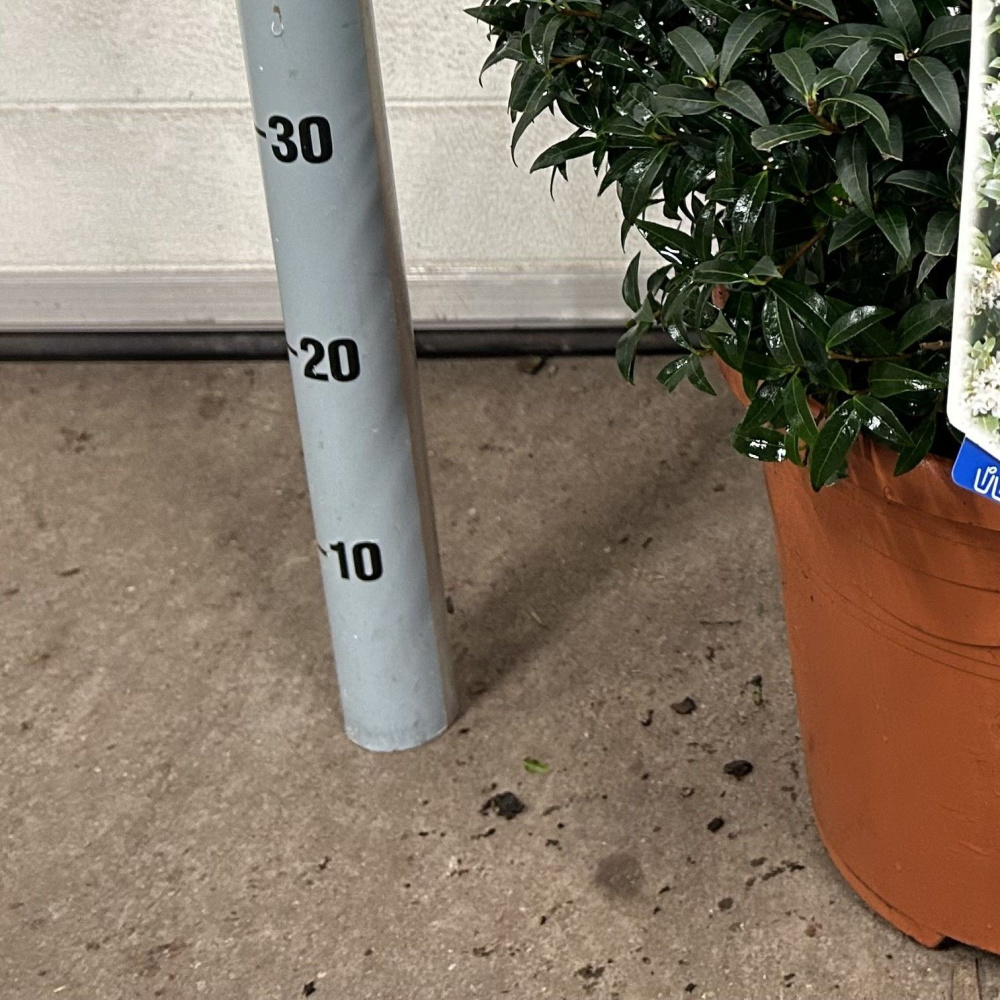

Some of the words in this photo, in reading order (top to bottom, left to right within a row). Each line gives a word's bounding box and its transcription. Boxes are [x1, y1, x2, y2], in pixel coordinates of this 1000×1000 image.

[269, 115, 333, 164] 30
[302, 337, 361, 382] 20
[330, 541, 383, 582] 10
